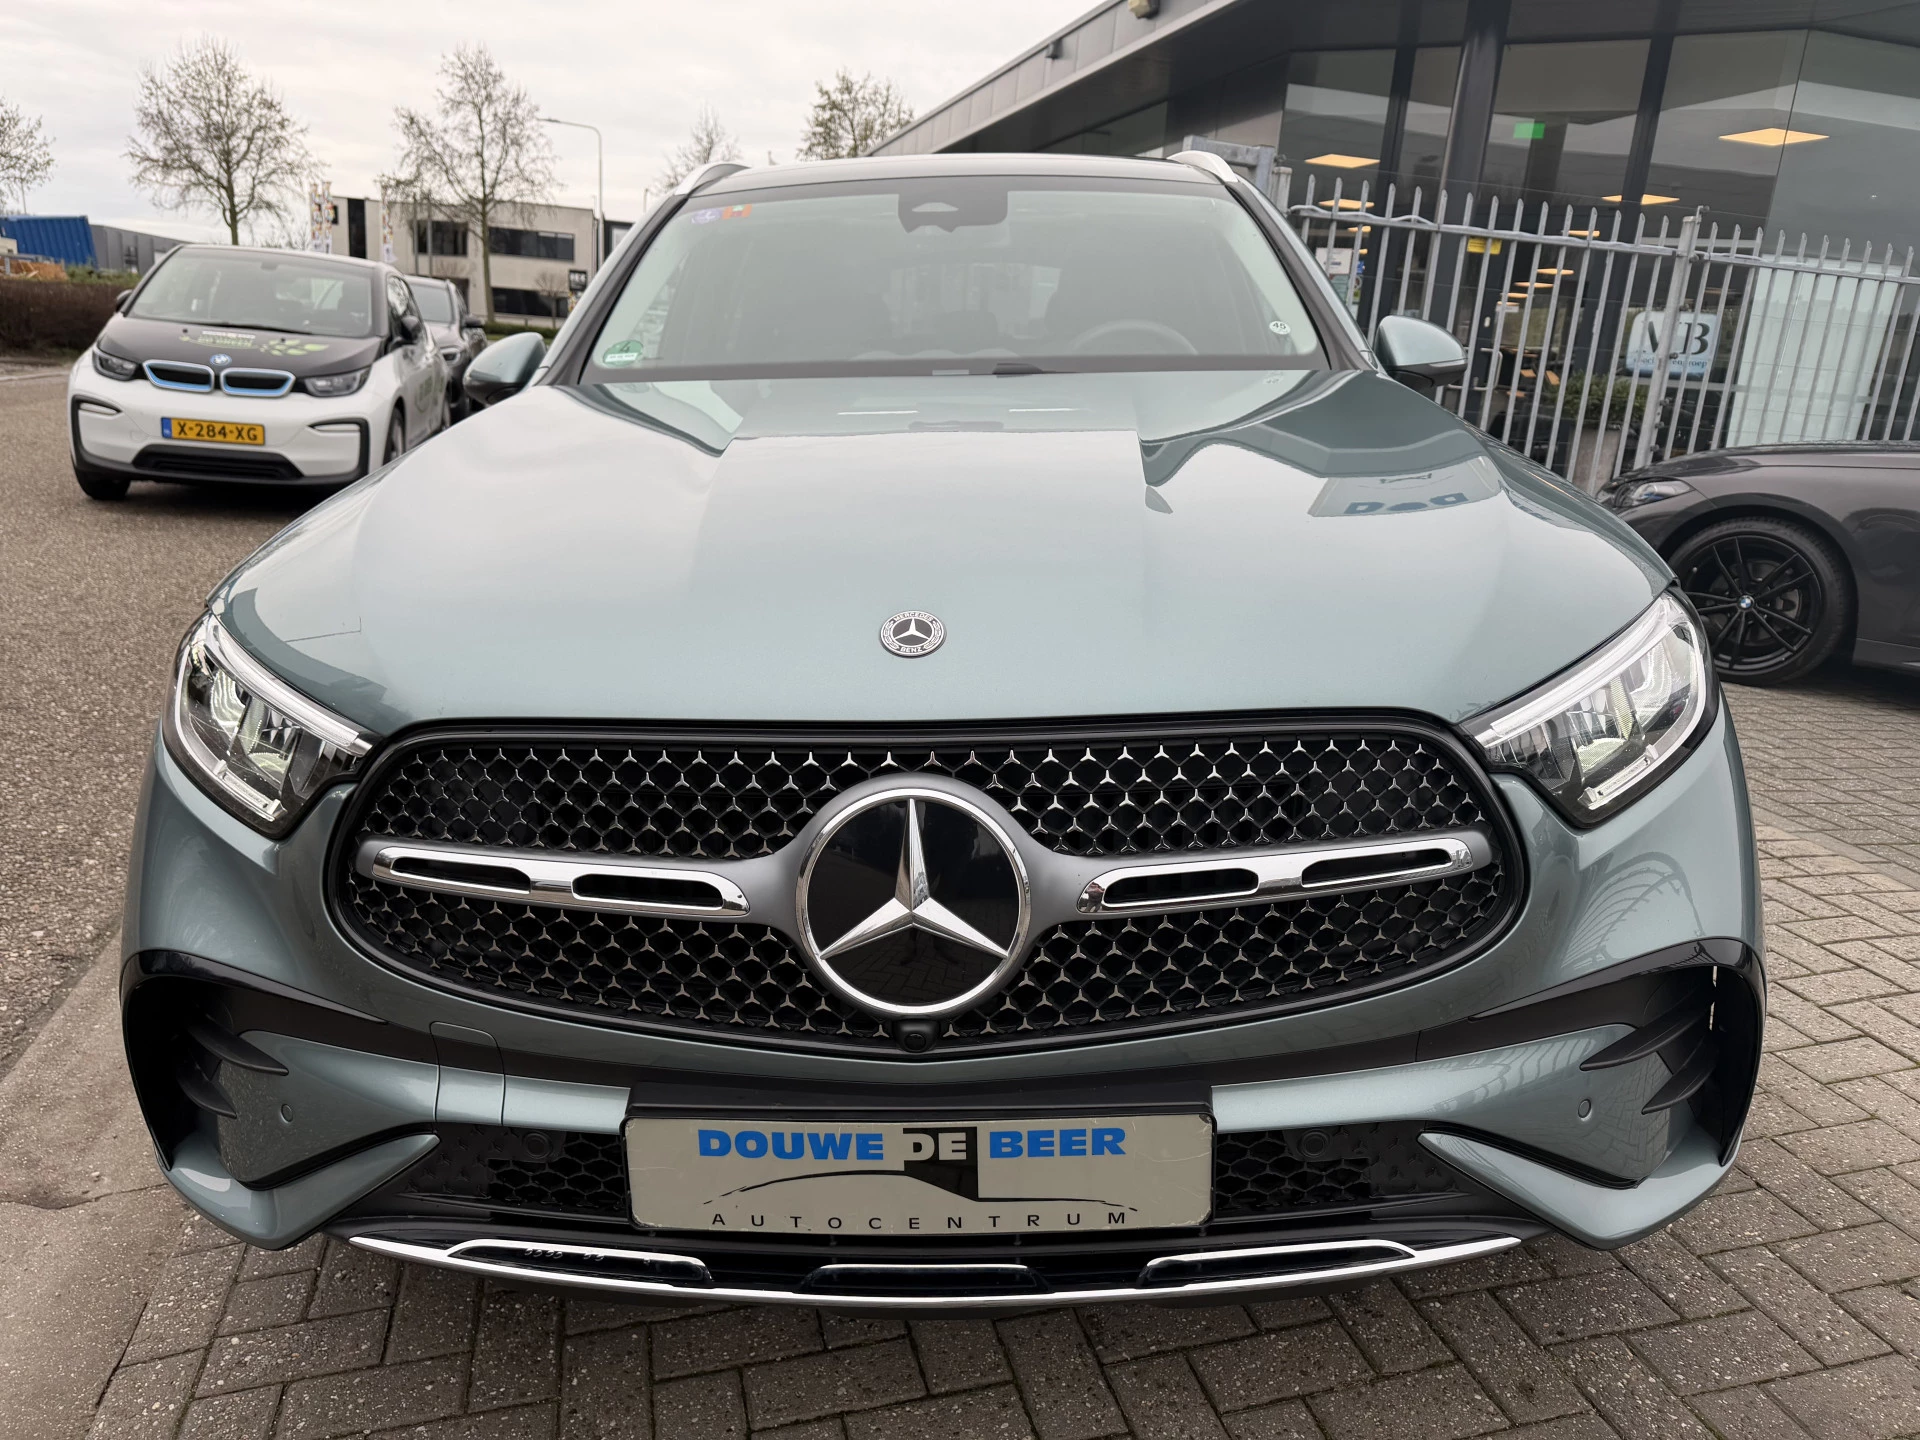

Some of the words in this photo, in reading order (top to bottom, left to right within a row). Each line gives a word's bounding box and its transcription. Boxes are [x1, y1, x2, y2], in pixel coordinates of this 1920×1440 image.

[177, 421, 258, 441] X-284-XG
[893, 612, 934, 621] MERCEDES
[698, 1129, 884, 1160] DOUWE
[904, 1132, 967, 1161] DE
[989, 1127, 1126, 1160] BEER
[711, 1211, 1127, 1230] AUTOCENTRUM
